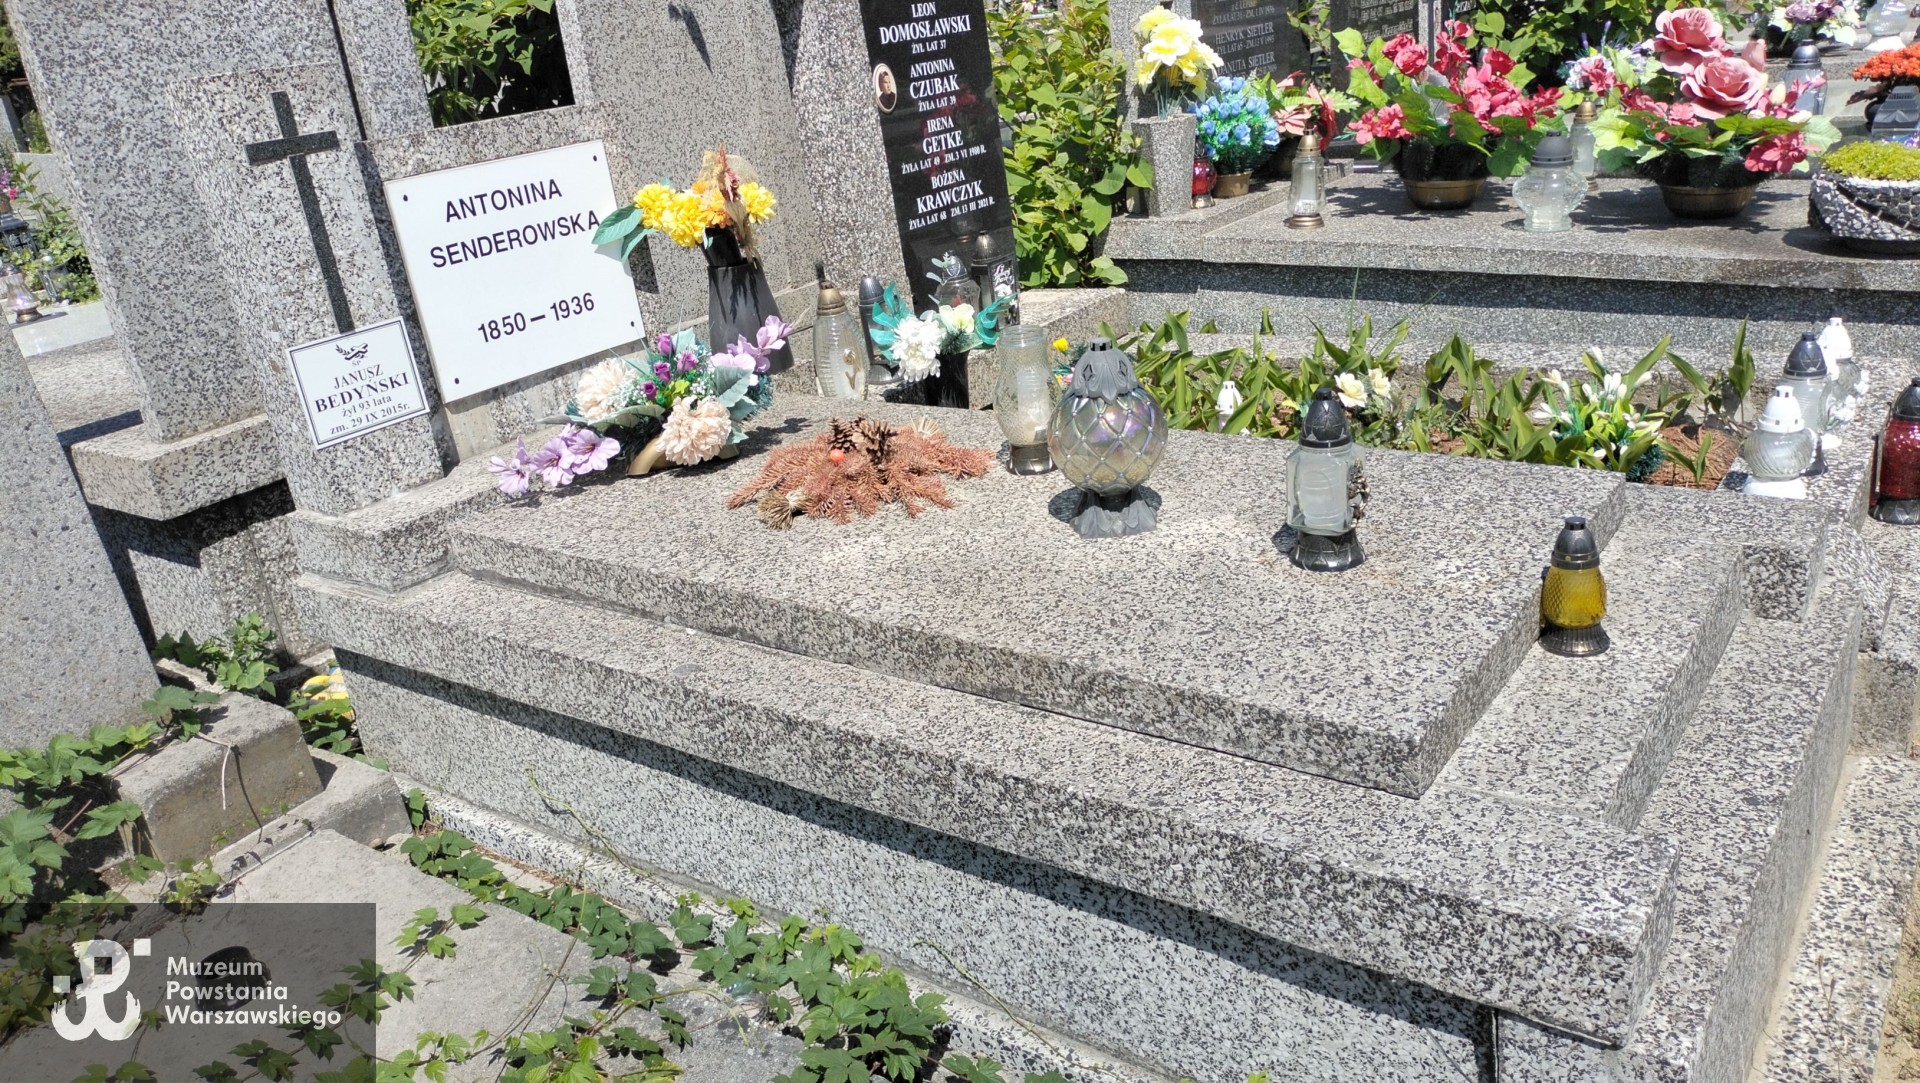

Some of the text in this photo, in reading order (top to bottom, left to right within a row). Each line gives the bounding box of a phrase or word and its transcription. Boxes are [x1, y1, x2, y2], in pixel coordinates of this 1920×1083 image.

[911, 1, 937, 18] LEON
[878, 14, 972, 45] DOMOSŁAWSKI
[1215, 28, 1244, 45] HENRYK
[926, 40, 938, 52] LAT
[940, 39, 947, 50] 37
[910, 57, 955, 78] ANTONINA
[910, 74, 960, 99] CZUBAK
[918, 101, 936, 112] ŻYŁA
[936, 98, 948, 109] LAT
[927, 115, 954, 133] IRENA
[922, 130, 964, 155] GETKE
[901, 162, 919, 175] ŻYŁA
[920, 158, 932, 170] LAT
[960, 148, 968, 159] VI
[931, 169, 965, 189] BOŻENA
[446, 178, 562, 223] ANTONINA
[916, 179, 984, 214] KRAWCZYK
[909, 218, 926, 230] ŻYŁA
[926, 213, 939, 225] LAT
[430, 210, 600, 268] SENDEROWSKA
[334, 364, 384, 390] JANUSZ
[315, 372, 409, 413] BEDYŃSKI
[359, 400, 371, 411] 93
[372, 395, 392, 407] lata
[330, 403, 410, 435] zm. 29 IX 2015r.
